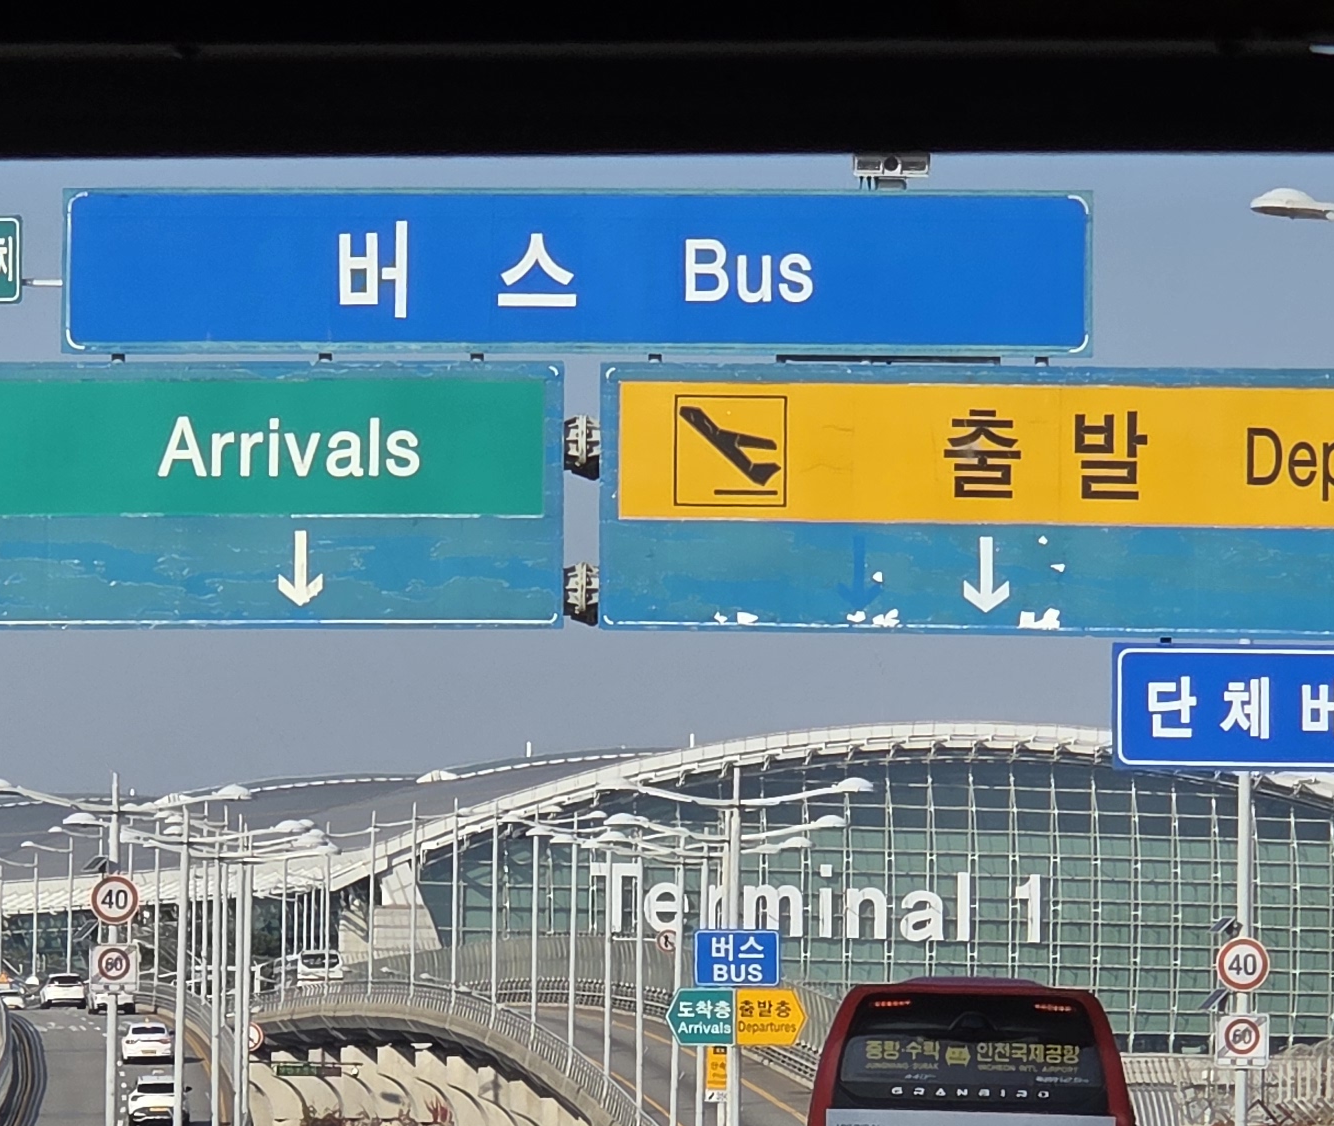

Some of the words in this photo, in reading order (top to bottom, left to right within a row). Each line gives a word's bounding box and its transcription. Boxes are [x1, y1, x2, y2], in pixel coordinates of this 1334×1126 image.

[685, 239, 813, 303] Bus
[157, 416, 420, 477] Arrivals
[101, 889, 128, 909] 40
[590, 862, 971, 942] Terminal
[1013, 873, 1042, 943] 1
[711, 934, 764, 961] 버스
[713, 964, 763, 982] BUS
[1228, 954, 1257, 976] 40
[677, 1000, 732, 1019] 도착층
[739, 1000, 792, 1018] 출발층
[677, 1022, 731, 1035] Arrivals
[738, 1021, 797, 1035] Departures
[976, 1042, 1080, 1064] 인천국제공항
